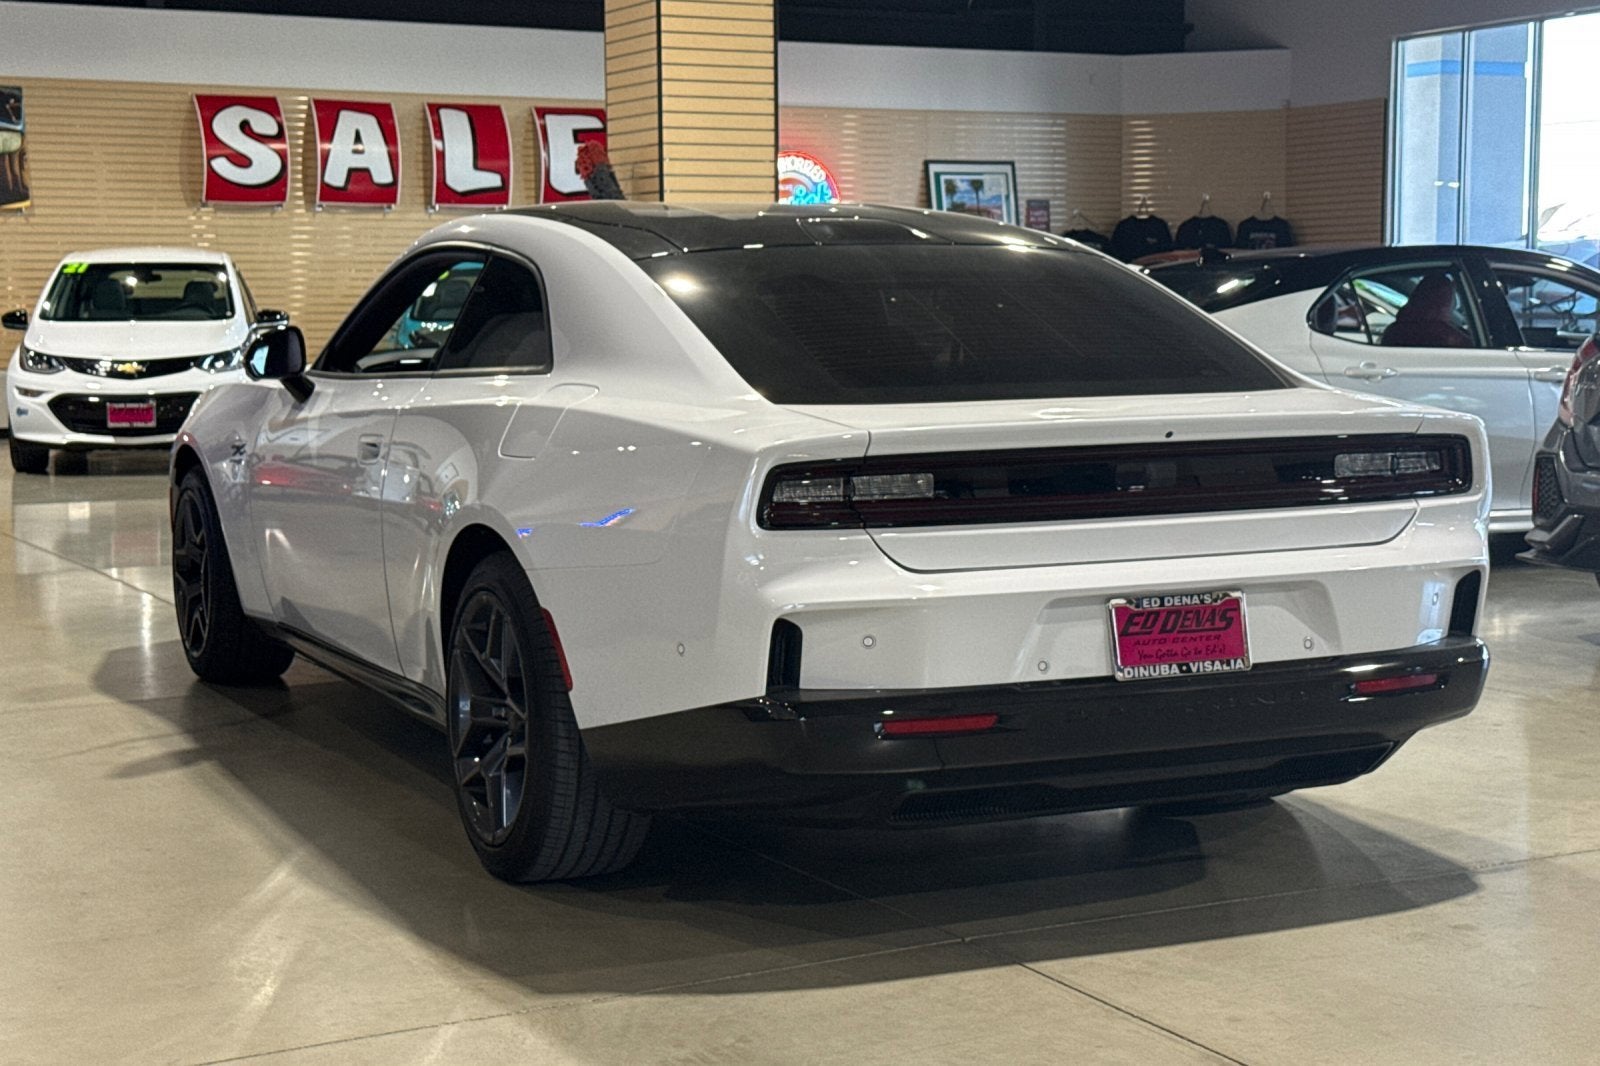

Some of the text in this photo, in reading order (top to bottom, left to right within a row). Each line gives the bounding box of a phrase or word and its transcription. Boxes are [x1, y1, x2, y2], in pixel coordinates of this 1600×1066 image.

[1142, 594, 1212, 608] ED DENA'S
[1120, 607, 1239, 636] ED DENA'S
[1134, 634, 1222, 646] AUTO CENTER
[1138, 650, 1154, 660] You
[1156, 648, 1178, 660] Gotta
[1181, 647, 1192, 657] Go
[1194, 646, 1201, 655] to
[1124, 659, 1245, 678] DINUBA VISALIA
